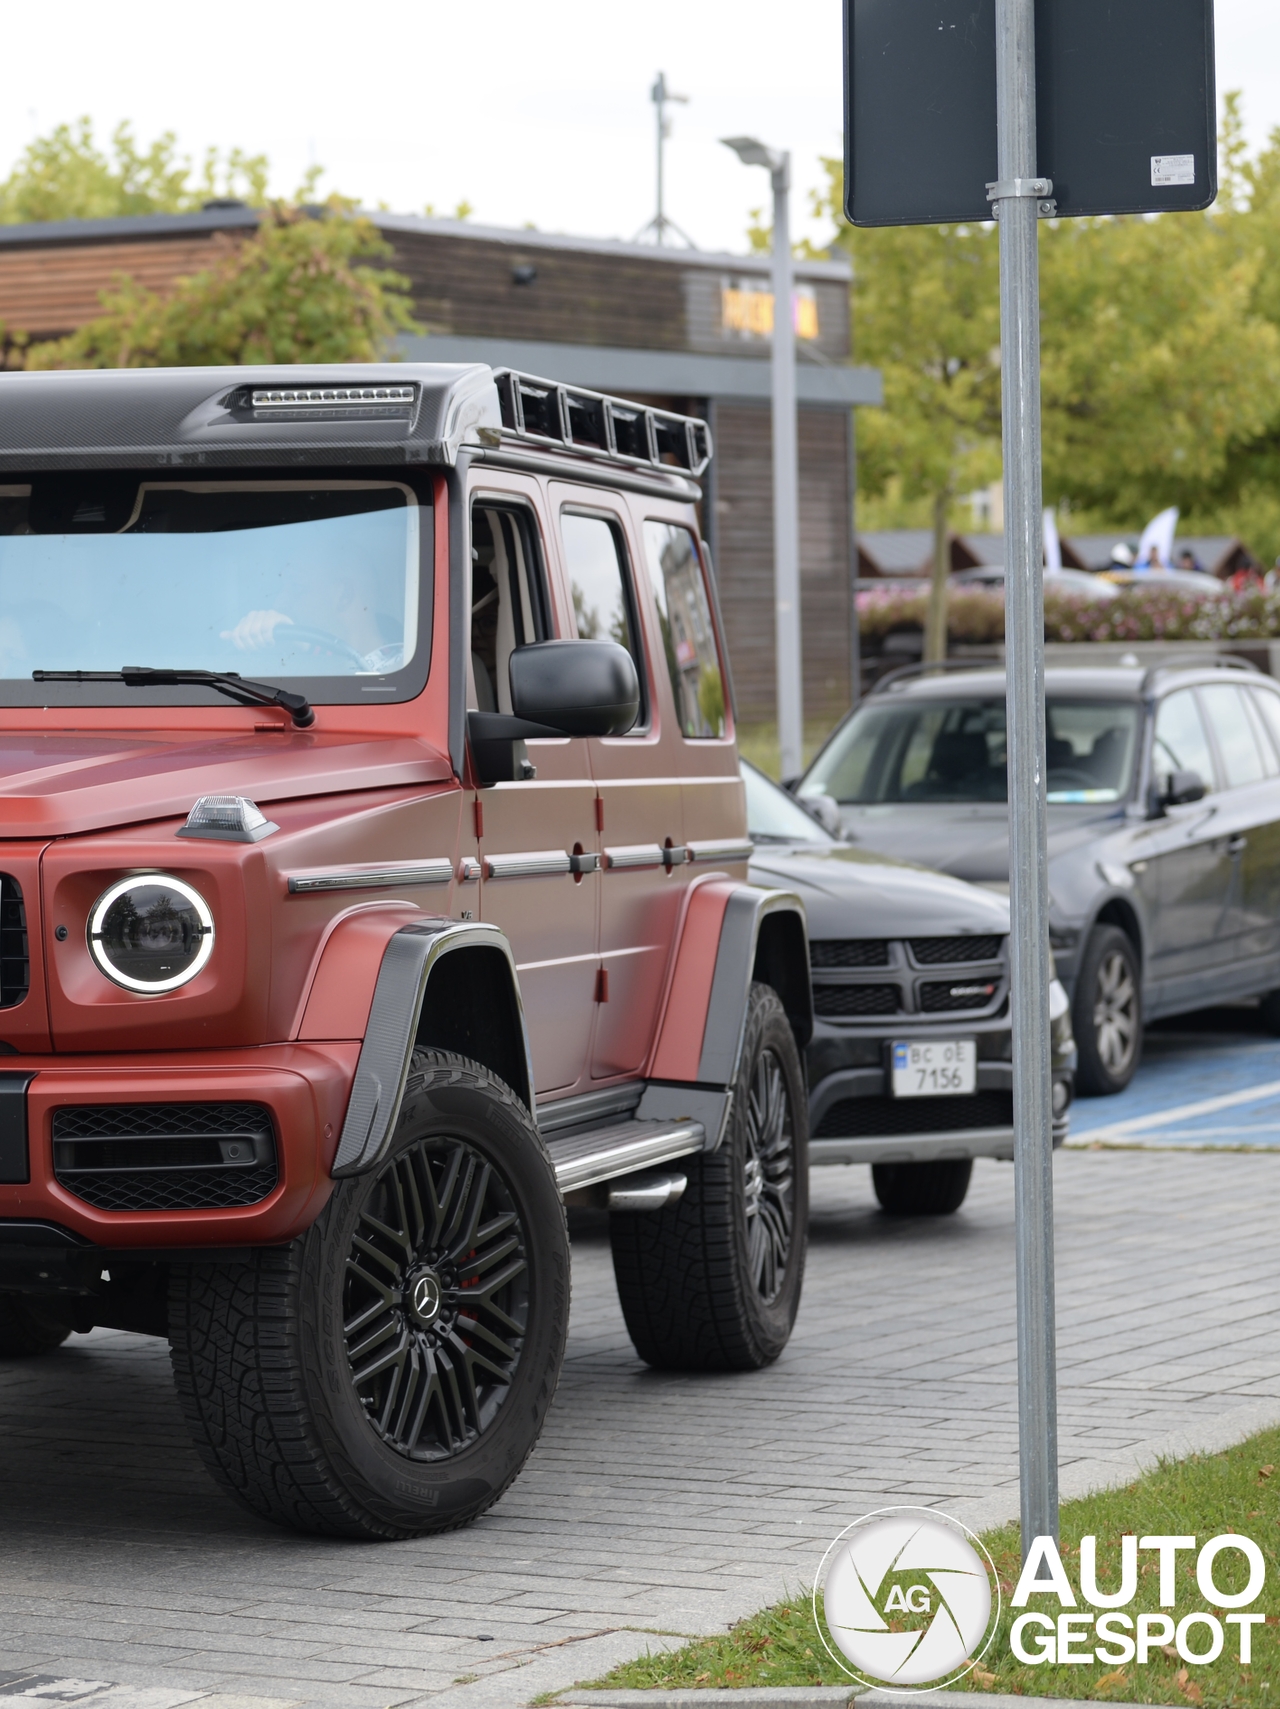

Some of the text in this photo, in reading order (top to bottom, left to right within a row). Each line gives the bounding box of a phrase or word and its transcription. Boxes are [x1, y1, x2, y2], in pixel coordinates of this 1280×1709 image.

[460, 909, 474, 920] V8
[911, 1047, 933, 1064] BC
[915, 1067, 963, 1090] 7156
[393, 1479, 440, 1508] PIRELLI
